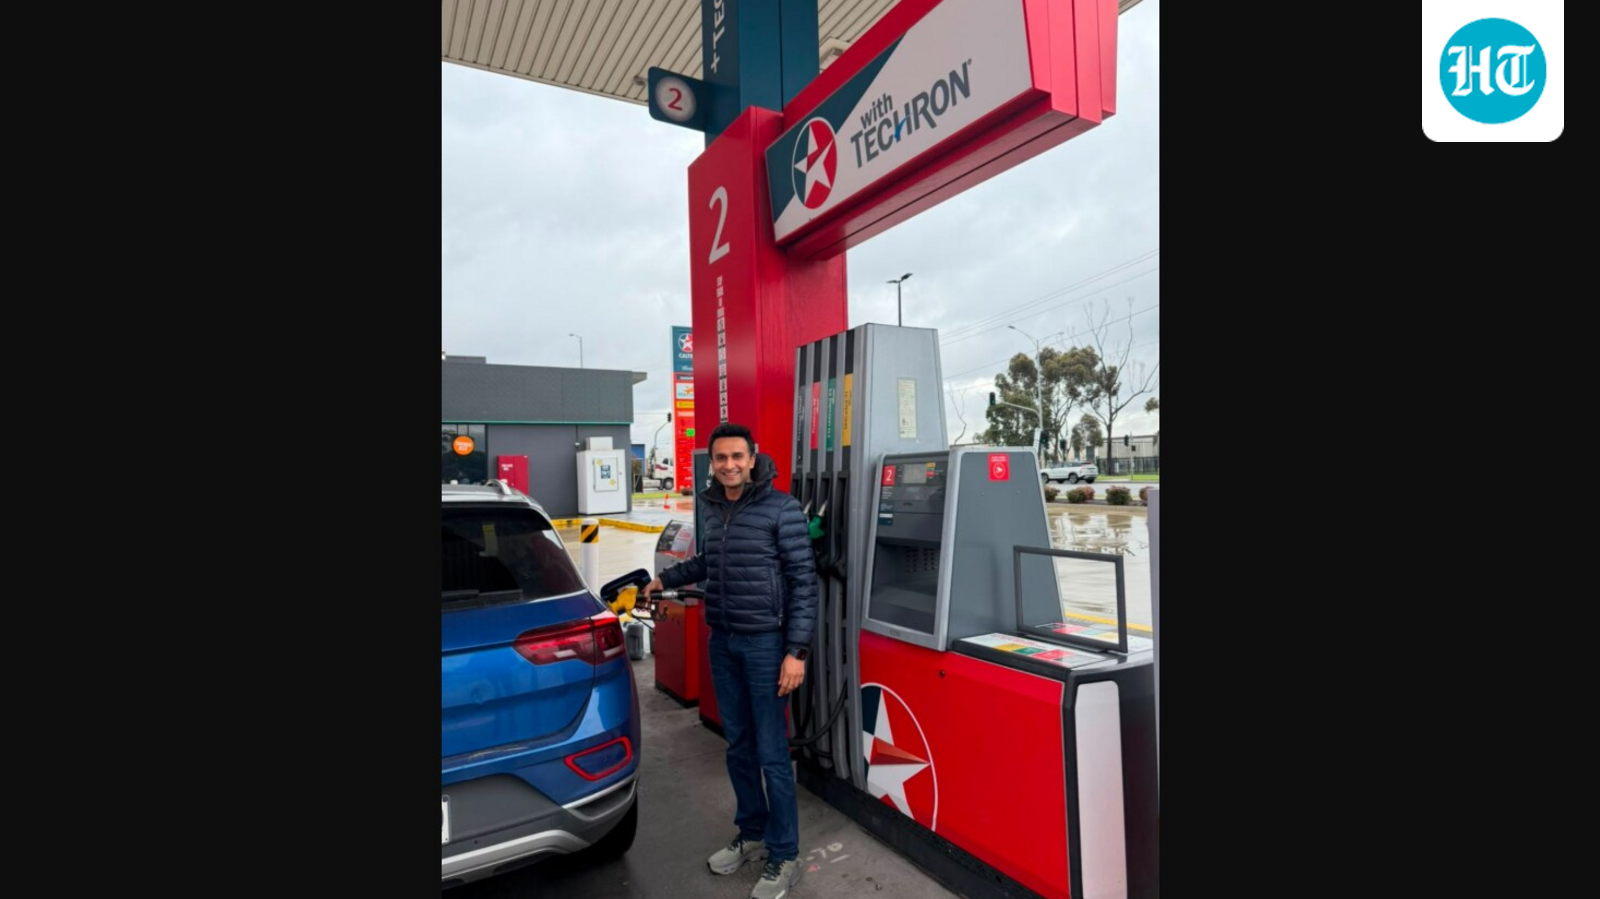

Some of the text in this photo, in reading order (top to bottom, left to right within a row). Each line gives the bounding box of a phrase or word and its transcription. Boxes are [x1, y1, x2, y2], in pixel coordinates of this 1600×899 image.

[668, 88, 683, 111] 2
[850, 61, 971, 168] TECHRON
[860, 92, 893, 129] with
[709, 186, 730, 264] 2
[886, 469, 892, 481] 2
